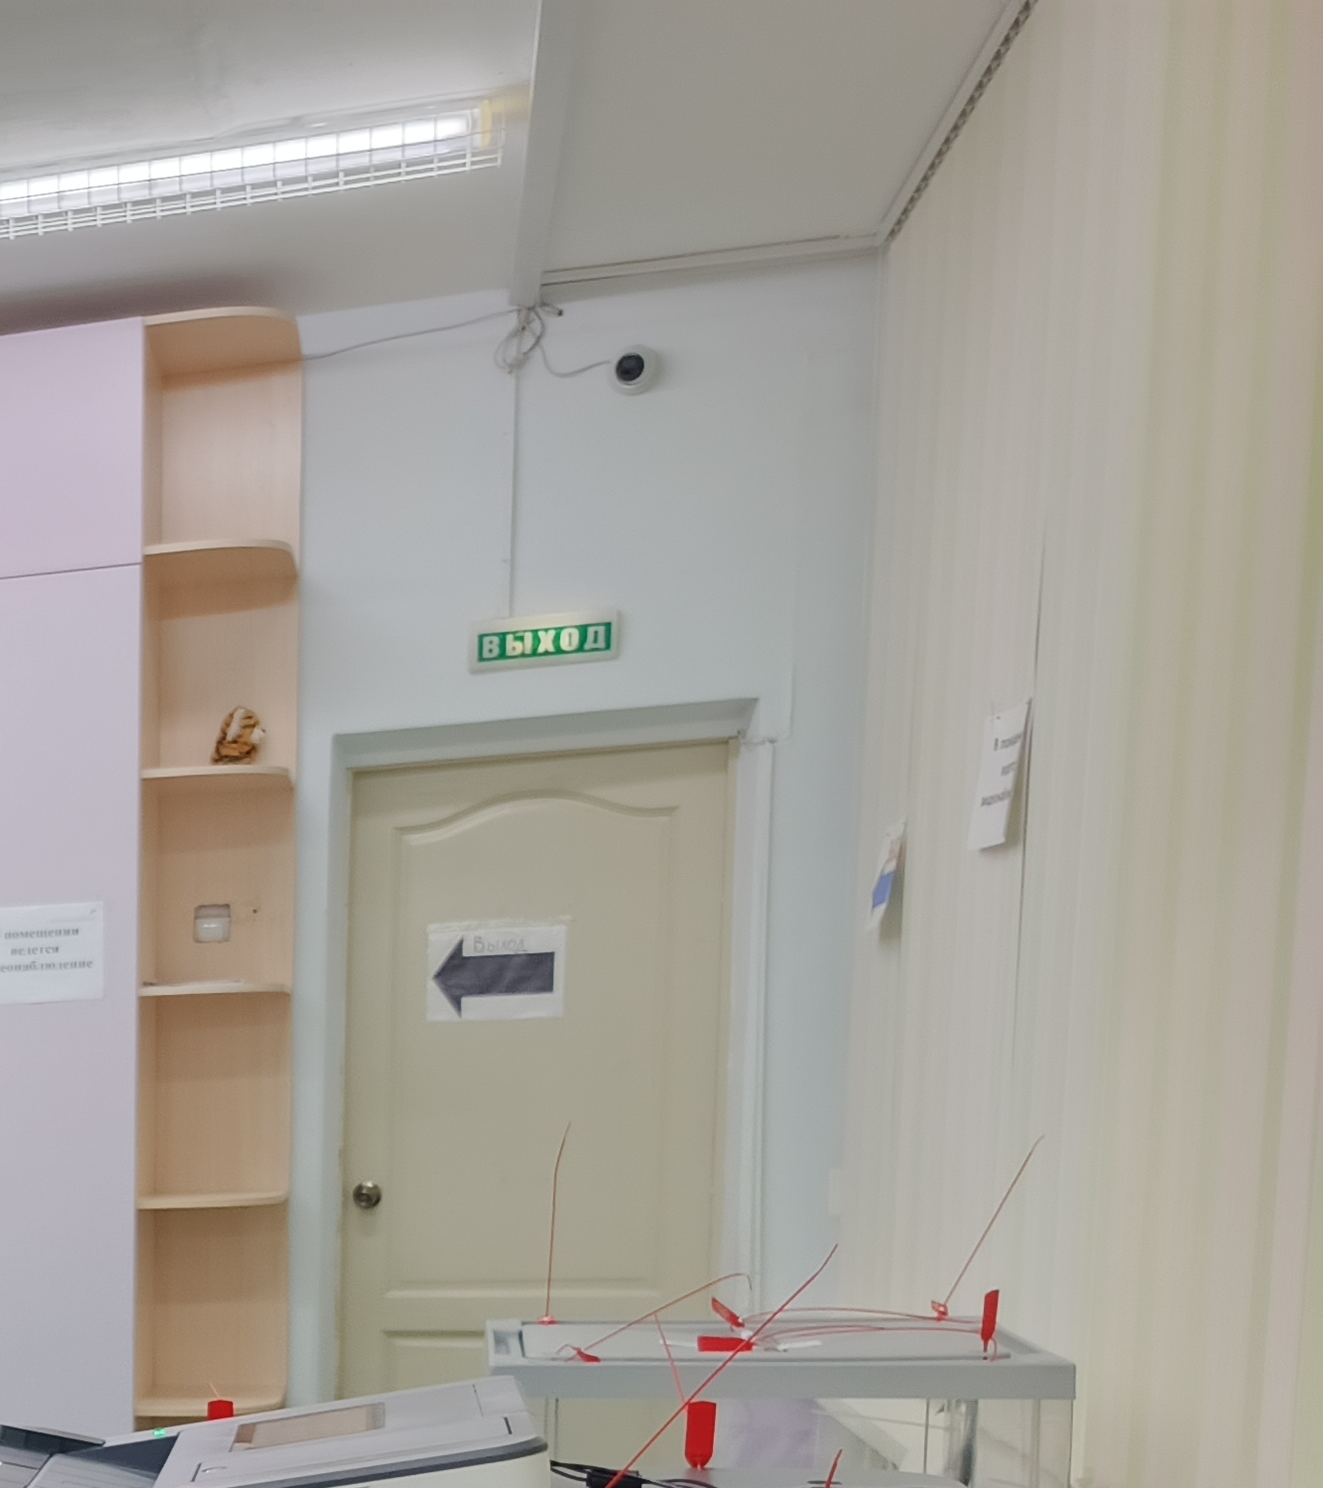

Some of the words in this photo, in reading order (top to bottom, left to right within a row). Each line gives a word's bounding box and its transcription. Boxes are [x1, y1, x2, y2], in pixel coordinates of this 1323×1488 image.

[482, 625, 606, 659] ВЫХОД
[4, 928, 79, 940] помещении
[10, 946, 59, 956] ведется
